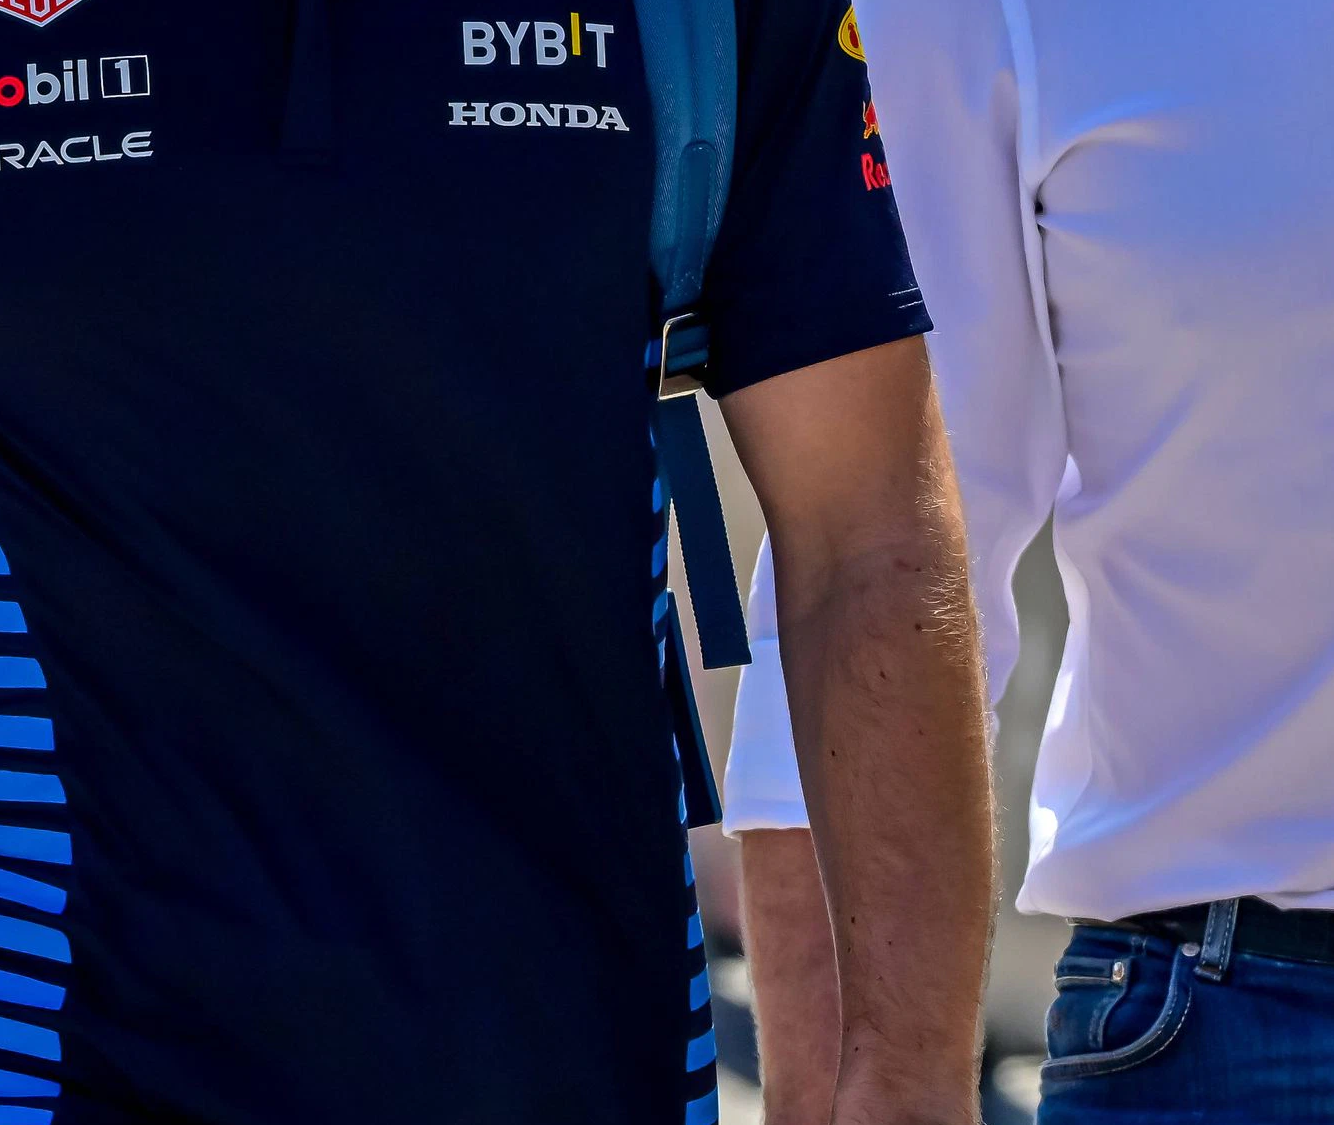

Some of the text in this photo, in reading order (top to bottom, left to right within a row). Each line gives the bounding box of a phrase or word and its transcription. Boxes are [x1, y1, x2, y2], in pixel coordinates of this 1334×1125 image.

[462, 12, 614, 68] BYBIT
[114, 59, 133, 94] 1
[448, 102, 630, 132] HONDA
